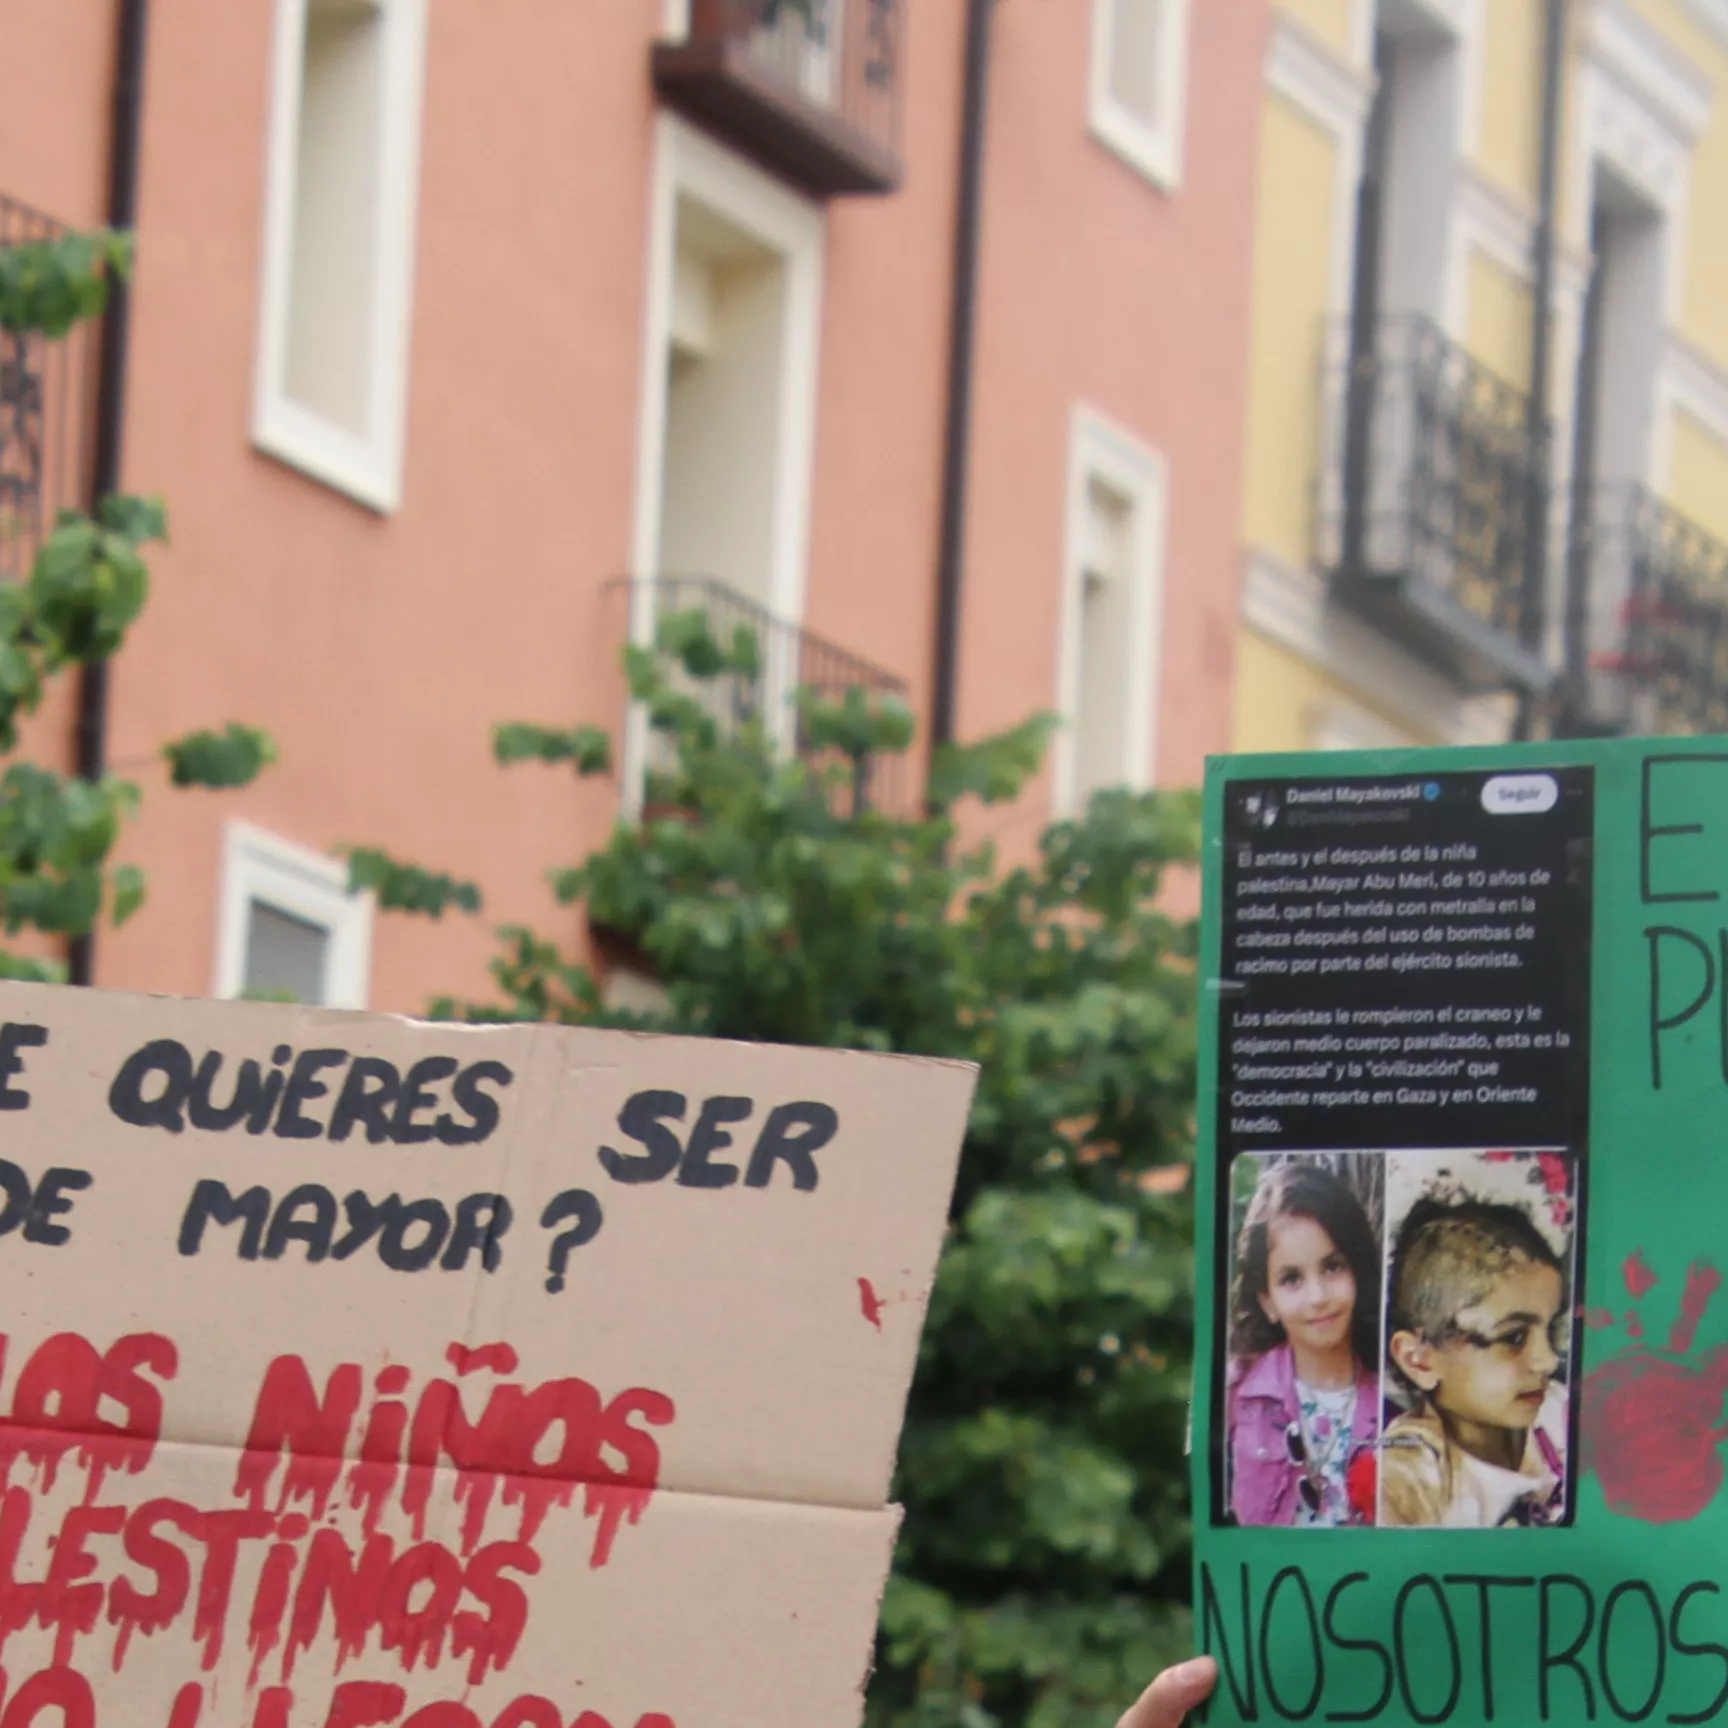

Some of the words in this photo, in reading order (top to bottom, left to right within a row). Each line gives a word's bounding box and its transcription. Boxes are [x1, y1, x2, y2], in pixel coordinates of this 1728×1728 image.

[1334, 783, 1420, 806] Mayakovski
[1236, 851, 1253, 869] El
[1253, 850, 1299, 867] antes
[1300, 852, 1311, 869] y
[1312, 846, 1328, 865] el
[1328, 843, 1398, 868] después
[1399, 843, 1422, 863] de
[1423, 843, 1440, 862] la
[1441, 842, 1477, 861] niña
[1234, 954, 1289, 974] racimo
[1289, 958, 1319, 976] por
[1319, 954, 1362, 975] parte
[1362, 952, 1389, 971] del
[1390, 950, 1454, 974] ejército
[1454, 948, 1524, 969] sionista.
[597, 1088, 839, 1192] SER
